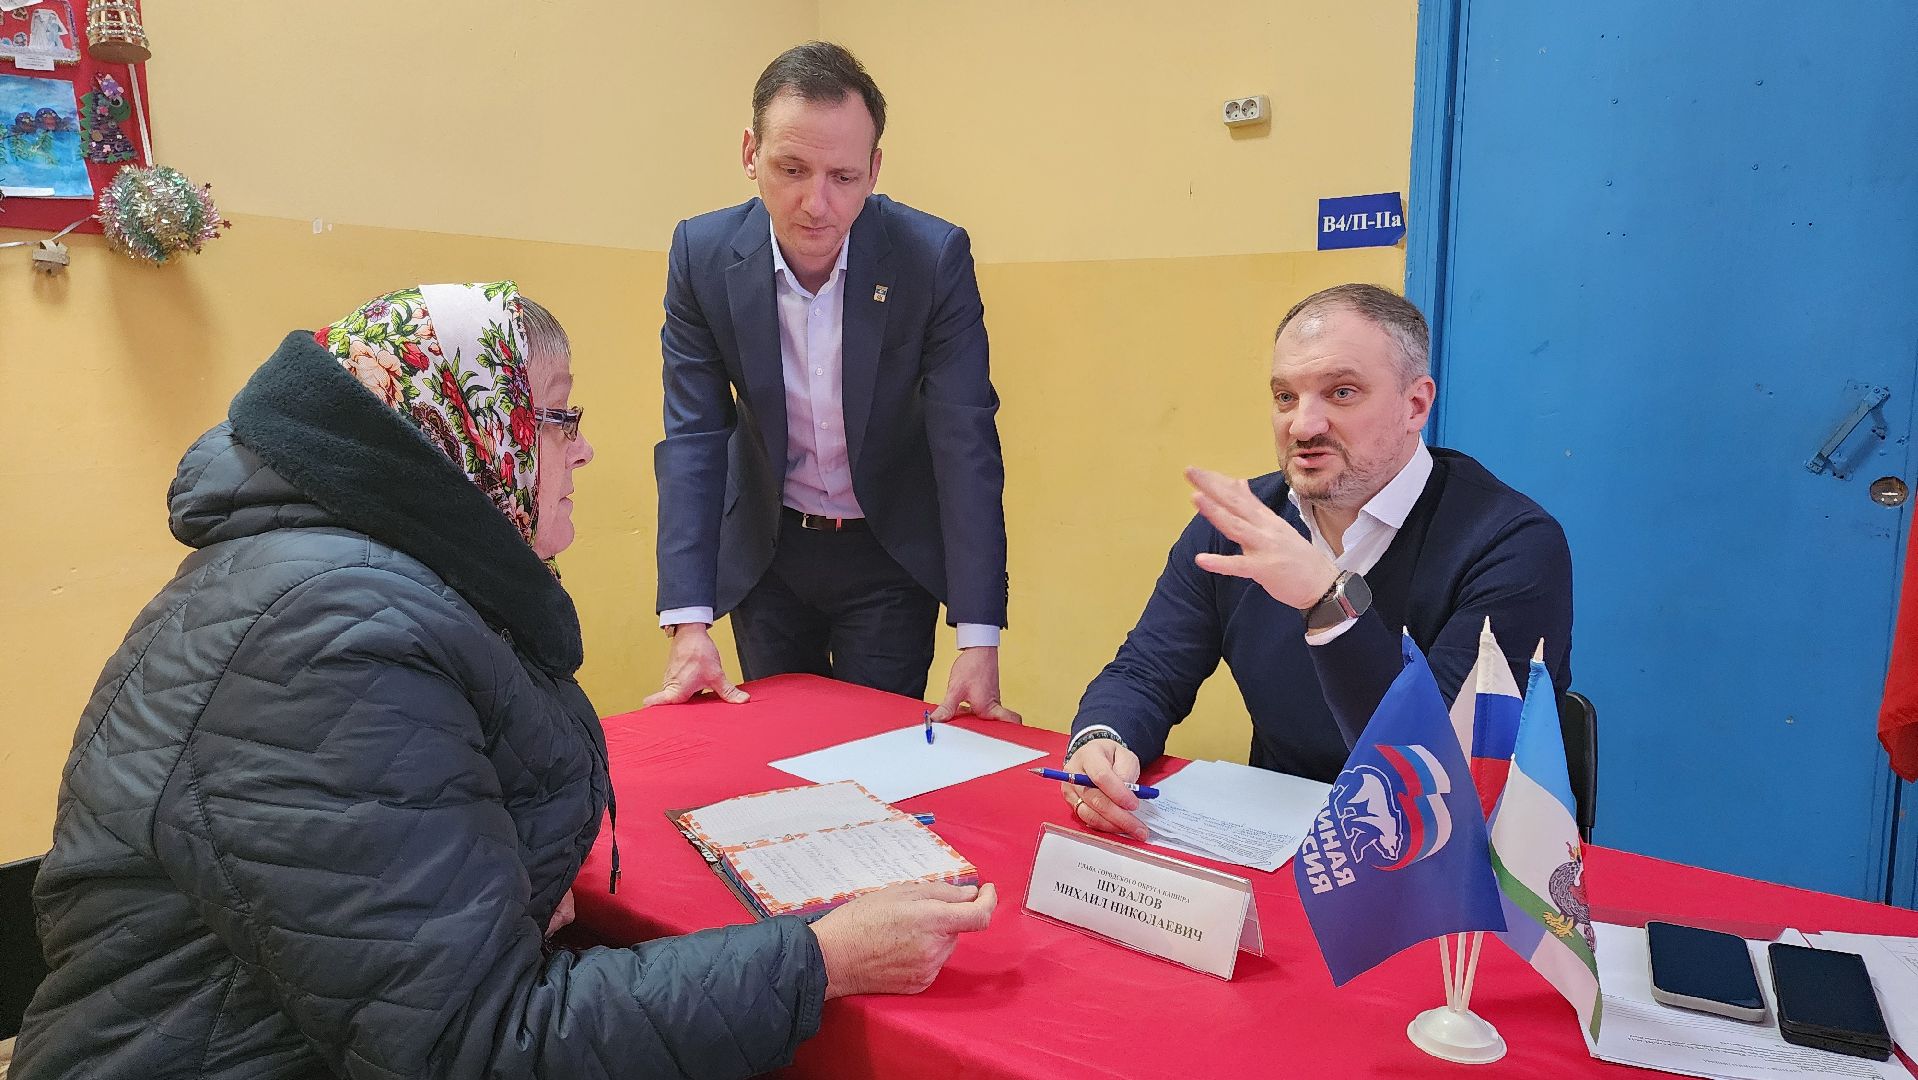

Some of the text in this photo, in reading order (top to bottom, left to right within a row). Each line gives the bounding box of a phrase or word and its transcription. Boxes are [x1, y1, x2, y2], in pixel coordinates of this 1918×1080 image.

[1318, 809, 1356, 888] ИНАЯ
[1053, 880, 1203, 942] МИХАИЛ НИКОЛАЕВИЧ
[1097, 878, 1163, 910] ШУВАЛОВ
